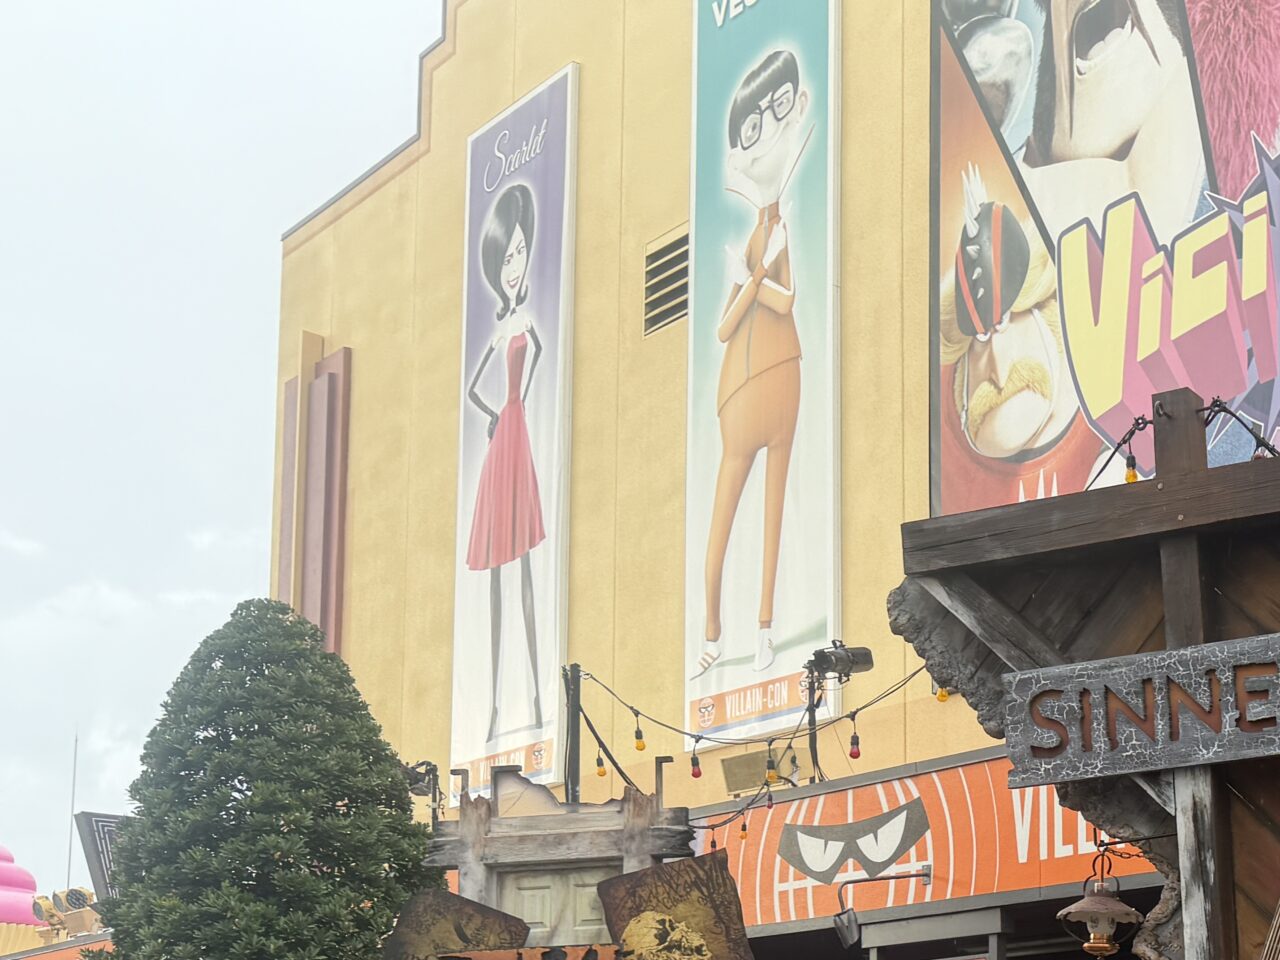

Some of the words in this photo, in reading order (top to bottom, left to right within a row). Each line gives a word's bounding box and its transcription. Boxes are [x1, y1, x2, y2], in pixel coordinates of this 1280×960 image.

[484, 118, 548, 192] Scarlet
[725, 680, 788, 719] VILLAIN-CON
[1012, 785, 1125, 864] VILL
